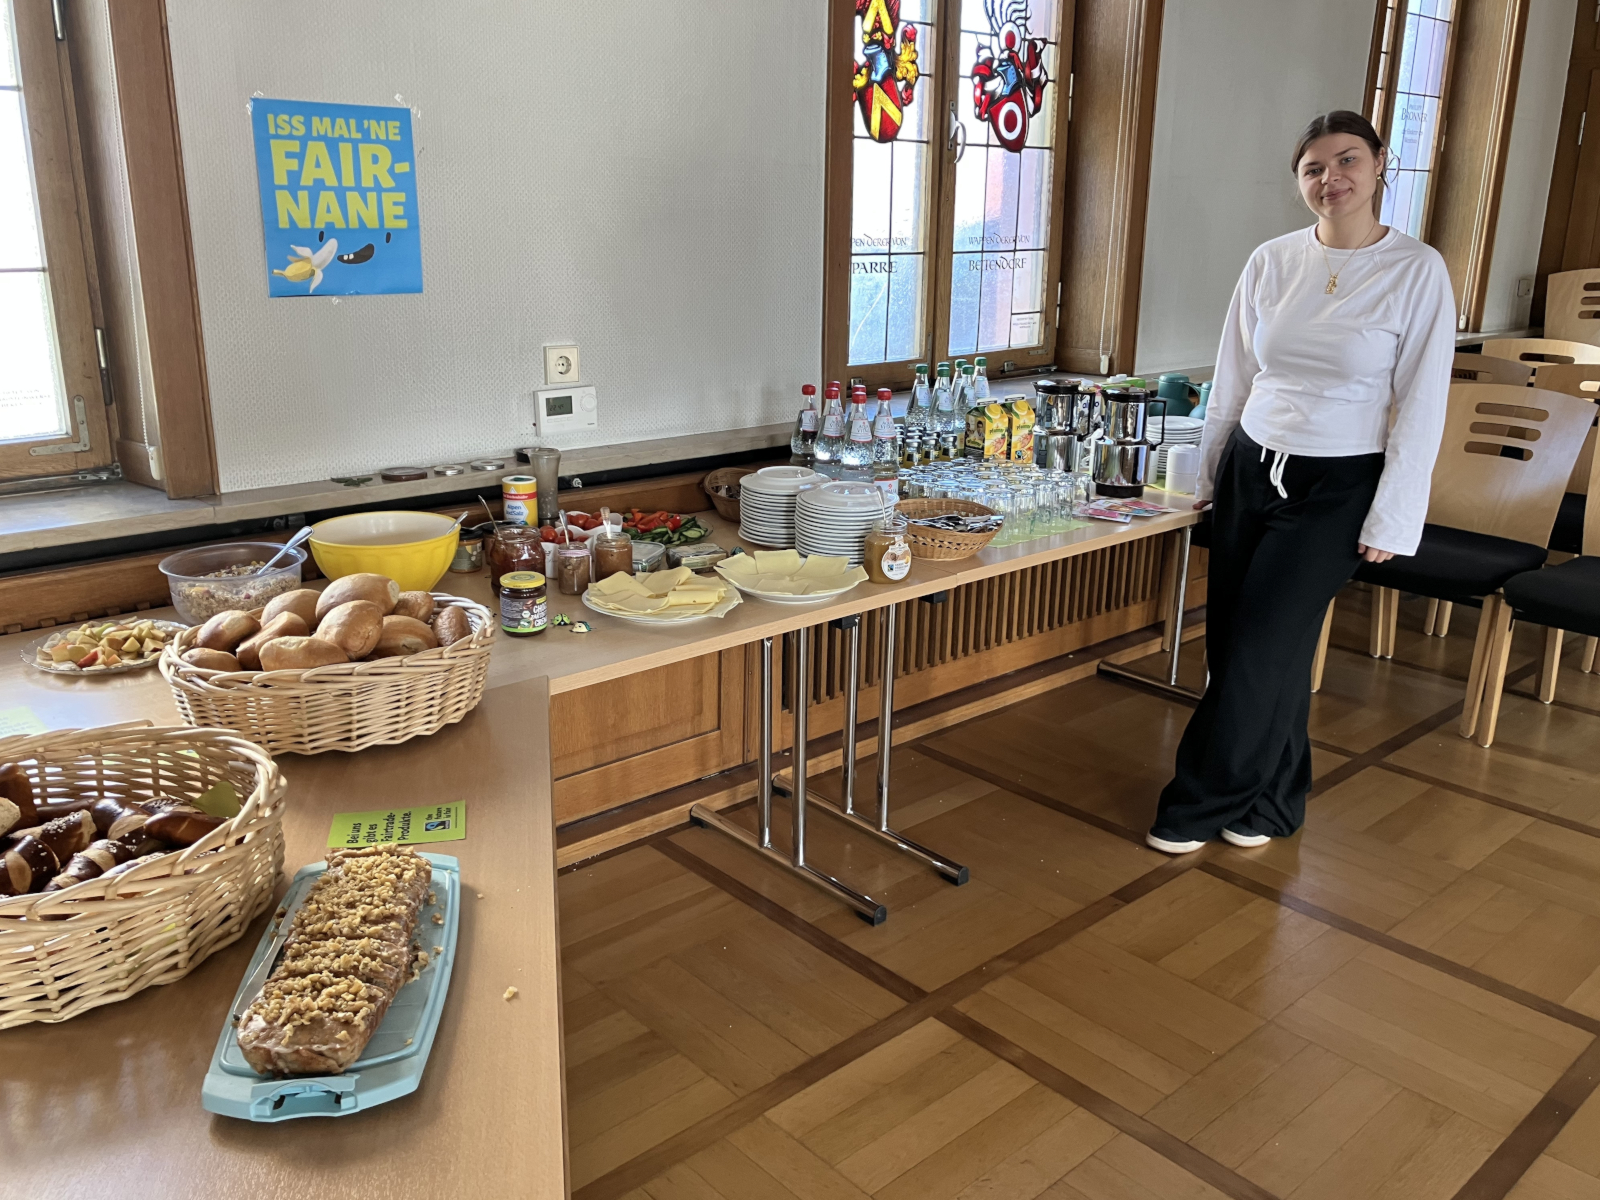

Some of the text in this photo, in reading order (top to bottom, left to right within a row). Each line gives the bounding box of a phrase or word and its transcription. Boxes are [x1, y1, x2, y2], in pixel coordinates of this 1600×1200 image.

[267, 113, 306, 136] ISS
[311, 115, 362, 139] MAL
[270, 139, 410, 188] FAIR-
[275, 189, 408, 229] NANE
[346, 822, 362, 844] Bei uns
[363, 823, 378, 843] gibt es
[380, 812, 396, 842] Fairtrade-
[397, 811, 411, 841] Produkte.
